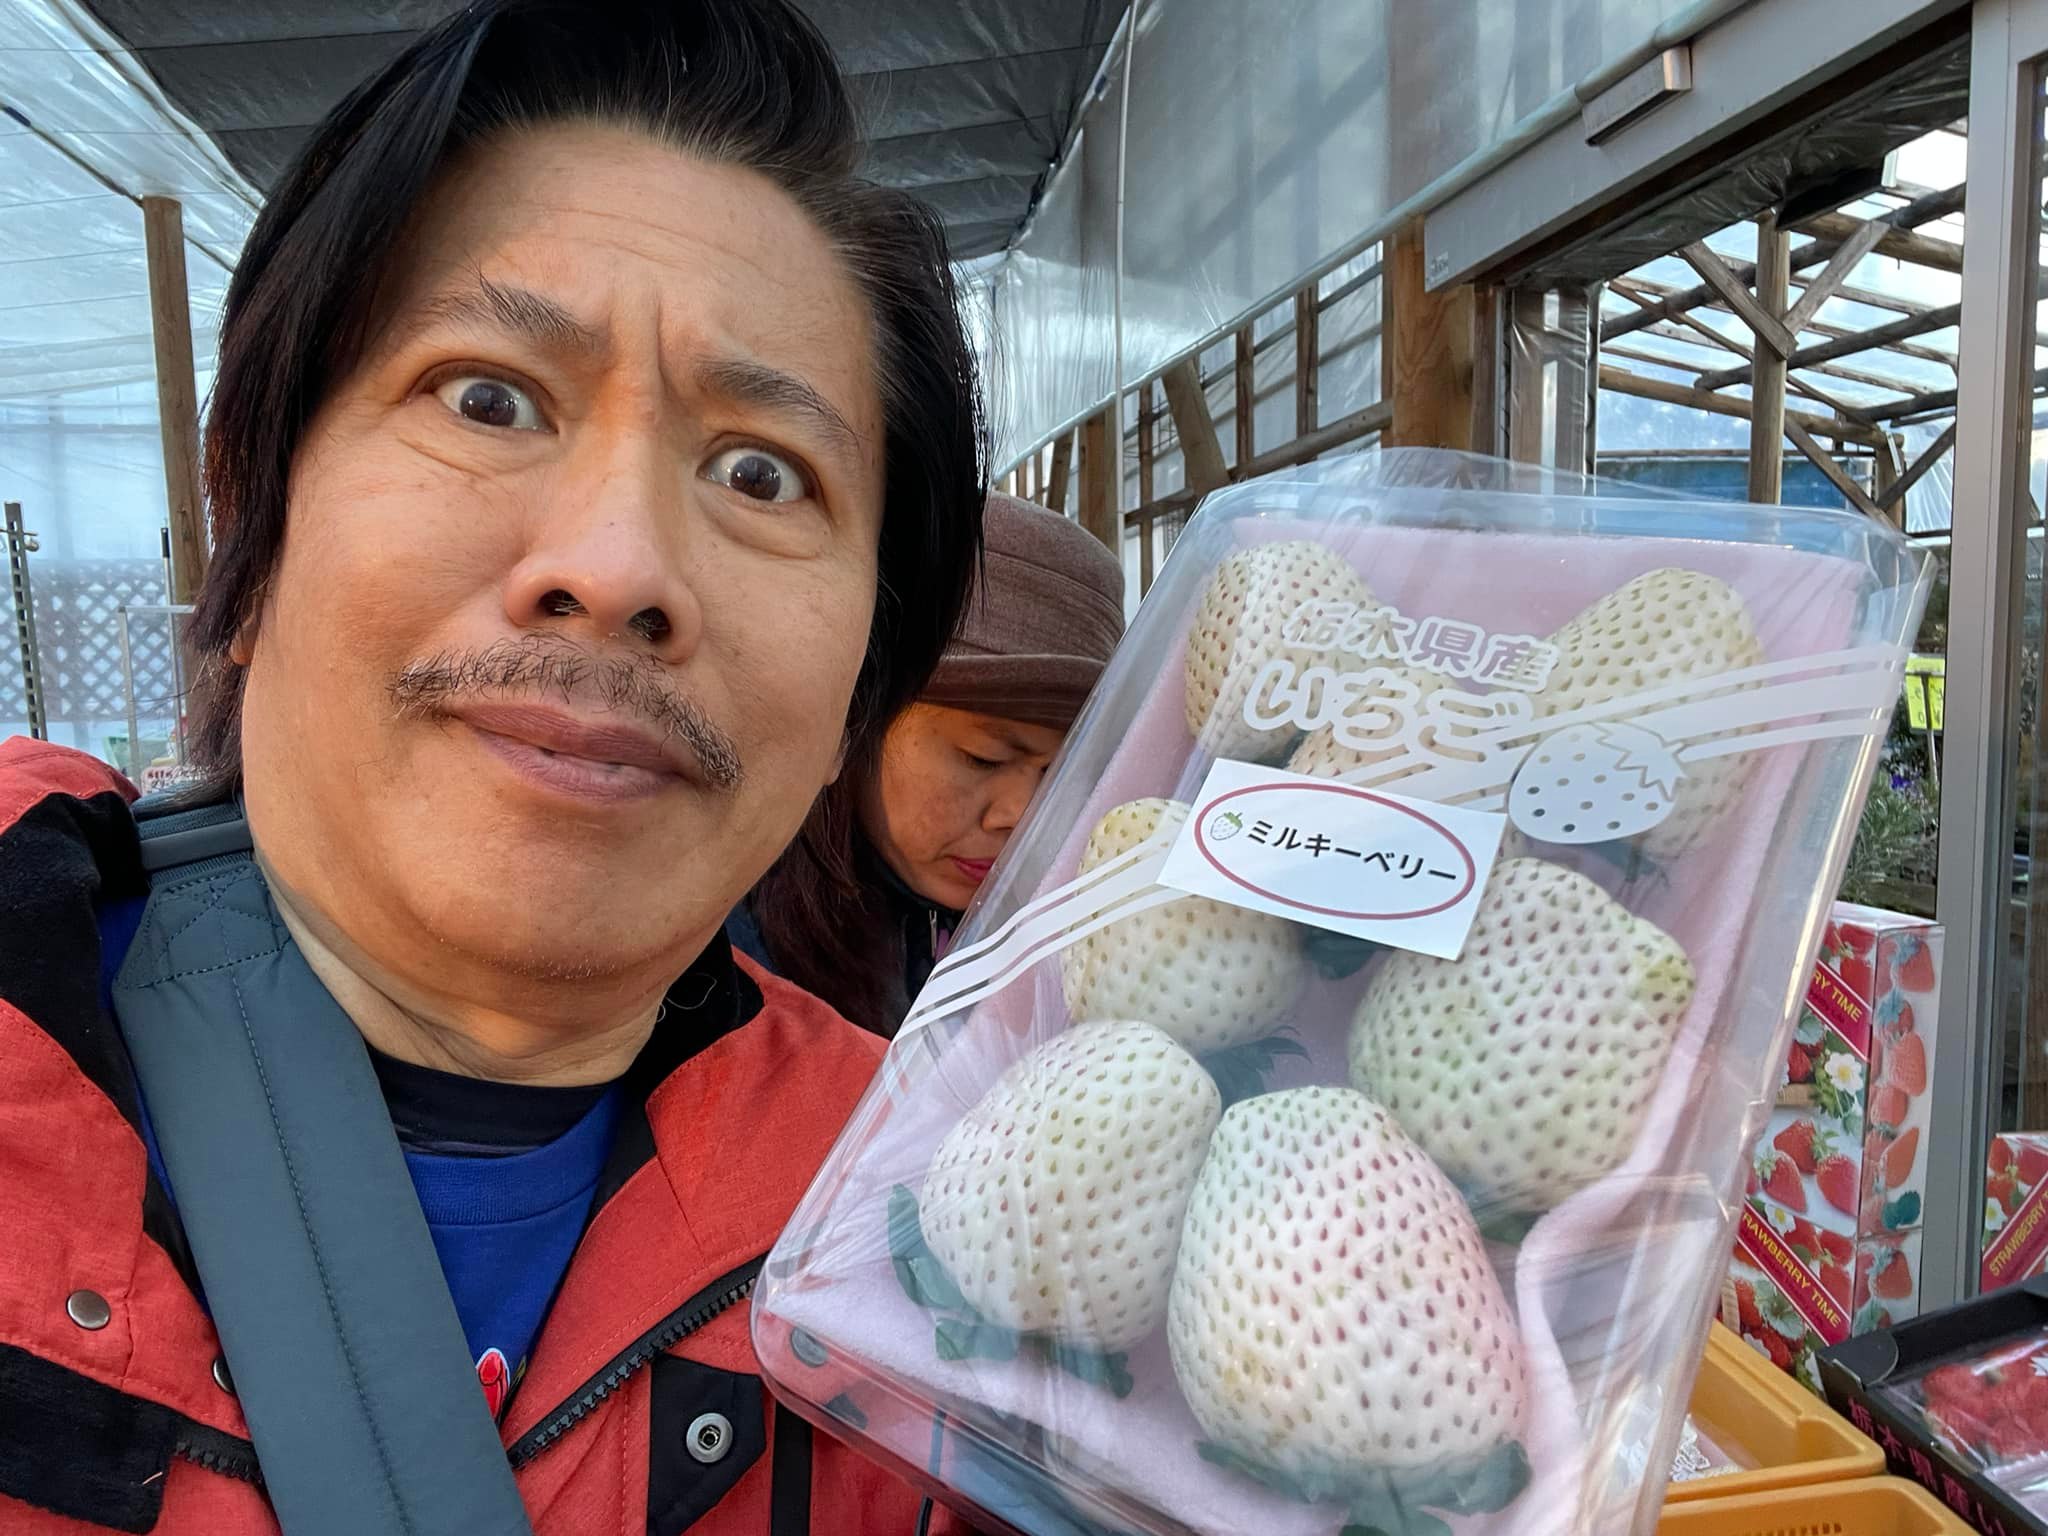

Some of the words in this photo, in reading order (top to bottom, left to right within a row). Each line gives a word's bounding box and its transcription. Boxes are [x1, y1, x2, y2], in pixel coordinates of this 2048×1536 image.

[1284, 600, 1559, 691] 栃木県産
[1248, 662, 1528, 764] いちご
[1247, 819, 1457, 880] ミルキーベリー
[1832, 986, 1863, 1023] TIME
[1743, 1212, 1810, 1289] RAWBERRY
[1811, 1288, 1841, 1328] TIME
[1989, 1199, 2047, 1276] STRAWBERRY
